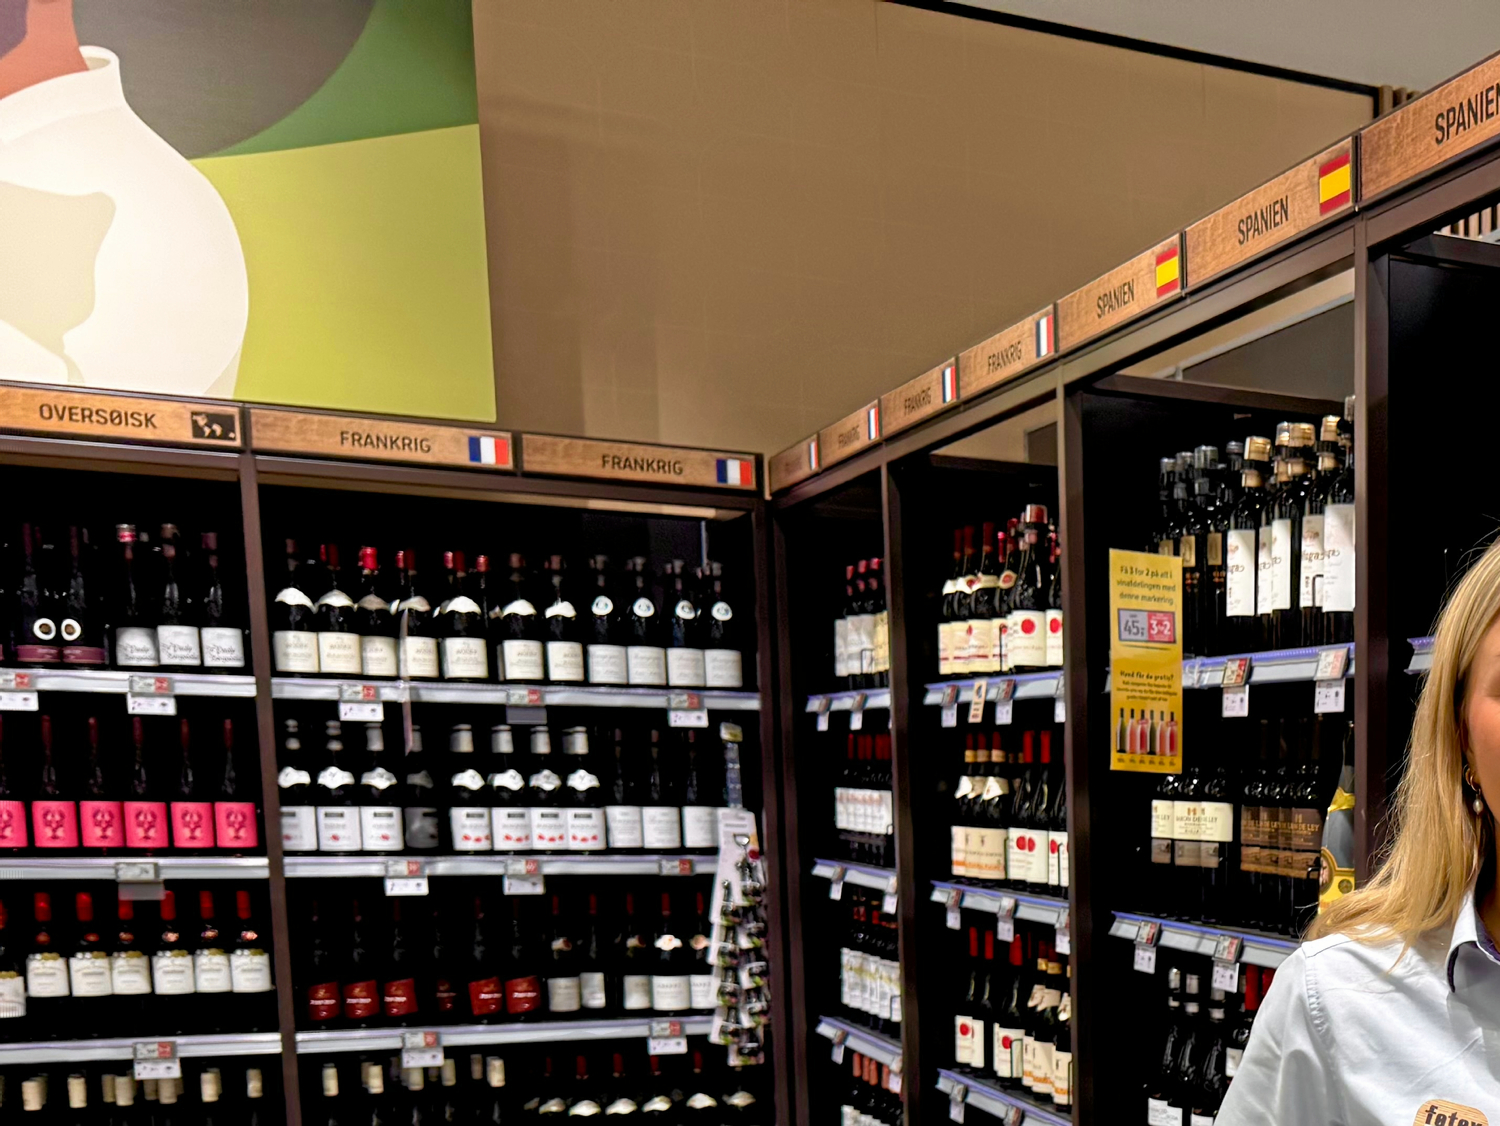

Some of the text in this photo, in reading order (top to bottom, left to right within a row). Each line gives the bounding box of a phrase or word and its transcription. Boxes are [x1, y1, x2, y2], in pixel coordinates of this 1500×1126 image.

[1238, 195, 1289, 245] SPANIEN
[1096, 279, 1134, 318] SPANIEN
[987, 341, 1022, 375] FRANKRIG
[39, 402, 157, 430] OVERSØISK
[904, 387, 932, 416] FRANKRIG
[339, 430, 431, 454] FRANKRIG
[600, 454, 683, 476] FRANKRIG
